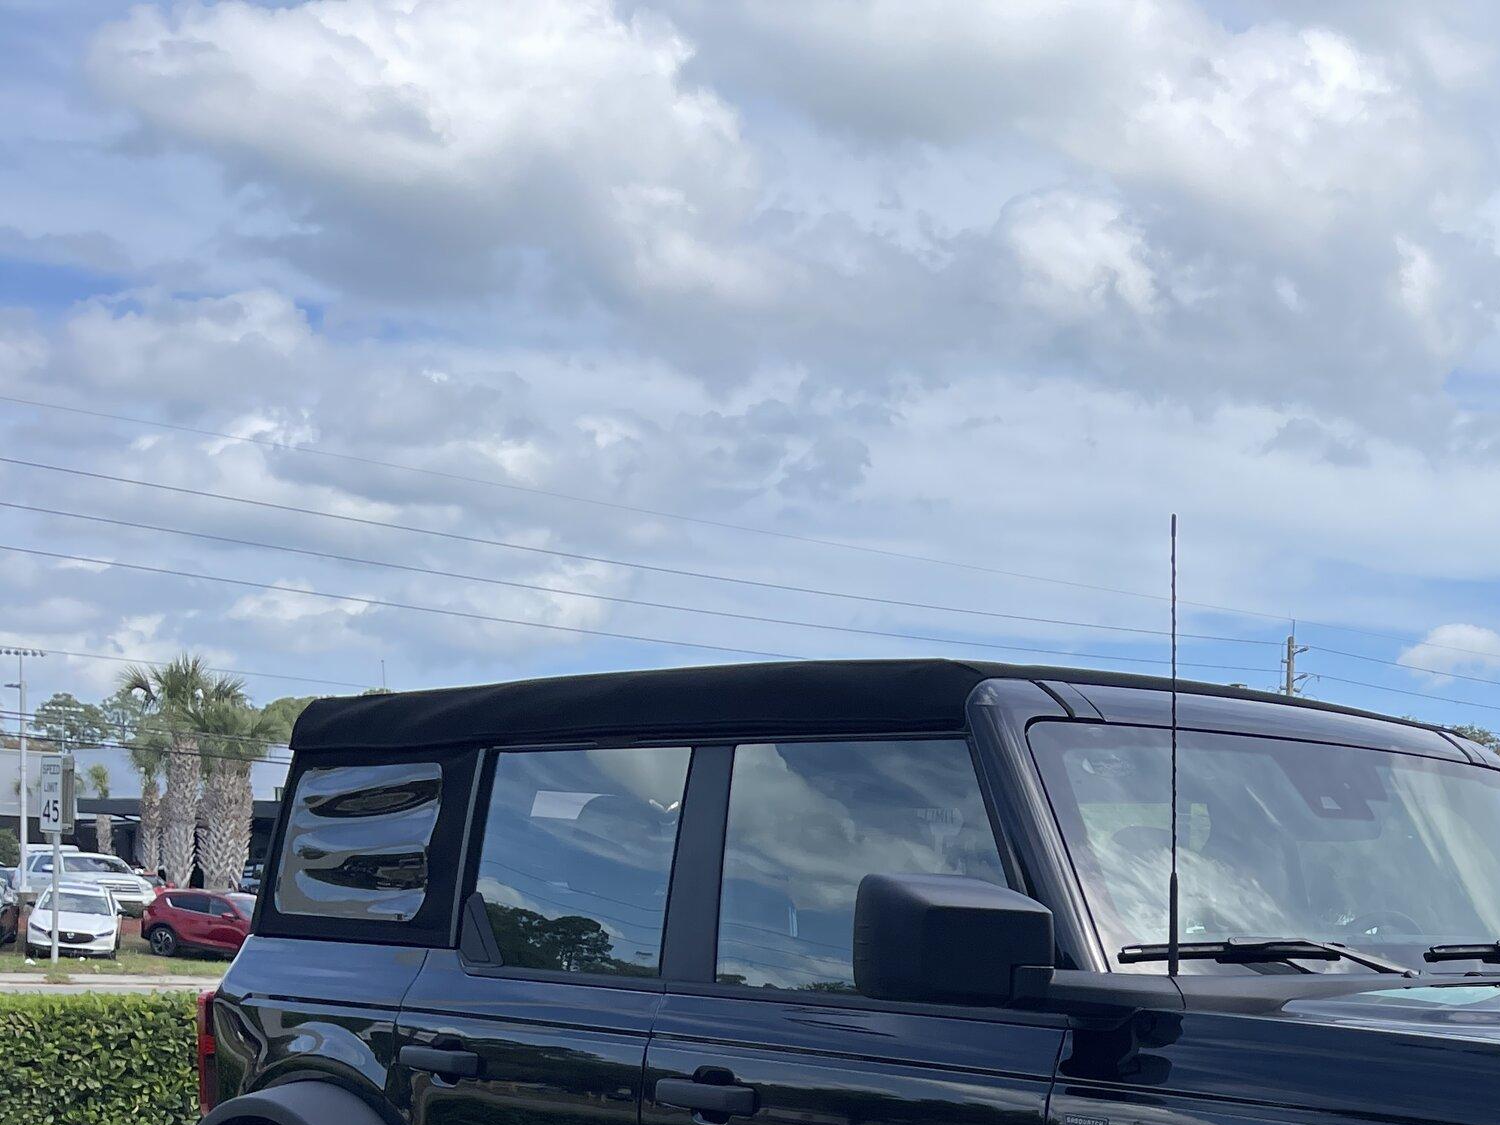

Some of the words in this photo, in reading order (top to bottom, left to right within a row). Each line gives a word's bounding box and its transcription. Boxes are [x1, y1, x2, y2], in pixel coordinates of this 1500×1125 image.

[42, 764, 60, 774] SPEED
[43, 782, 58, 792] LIMIT
[43, 800, 59, 823] 45
